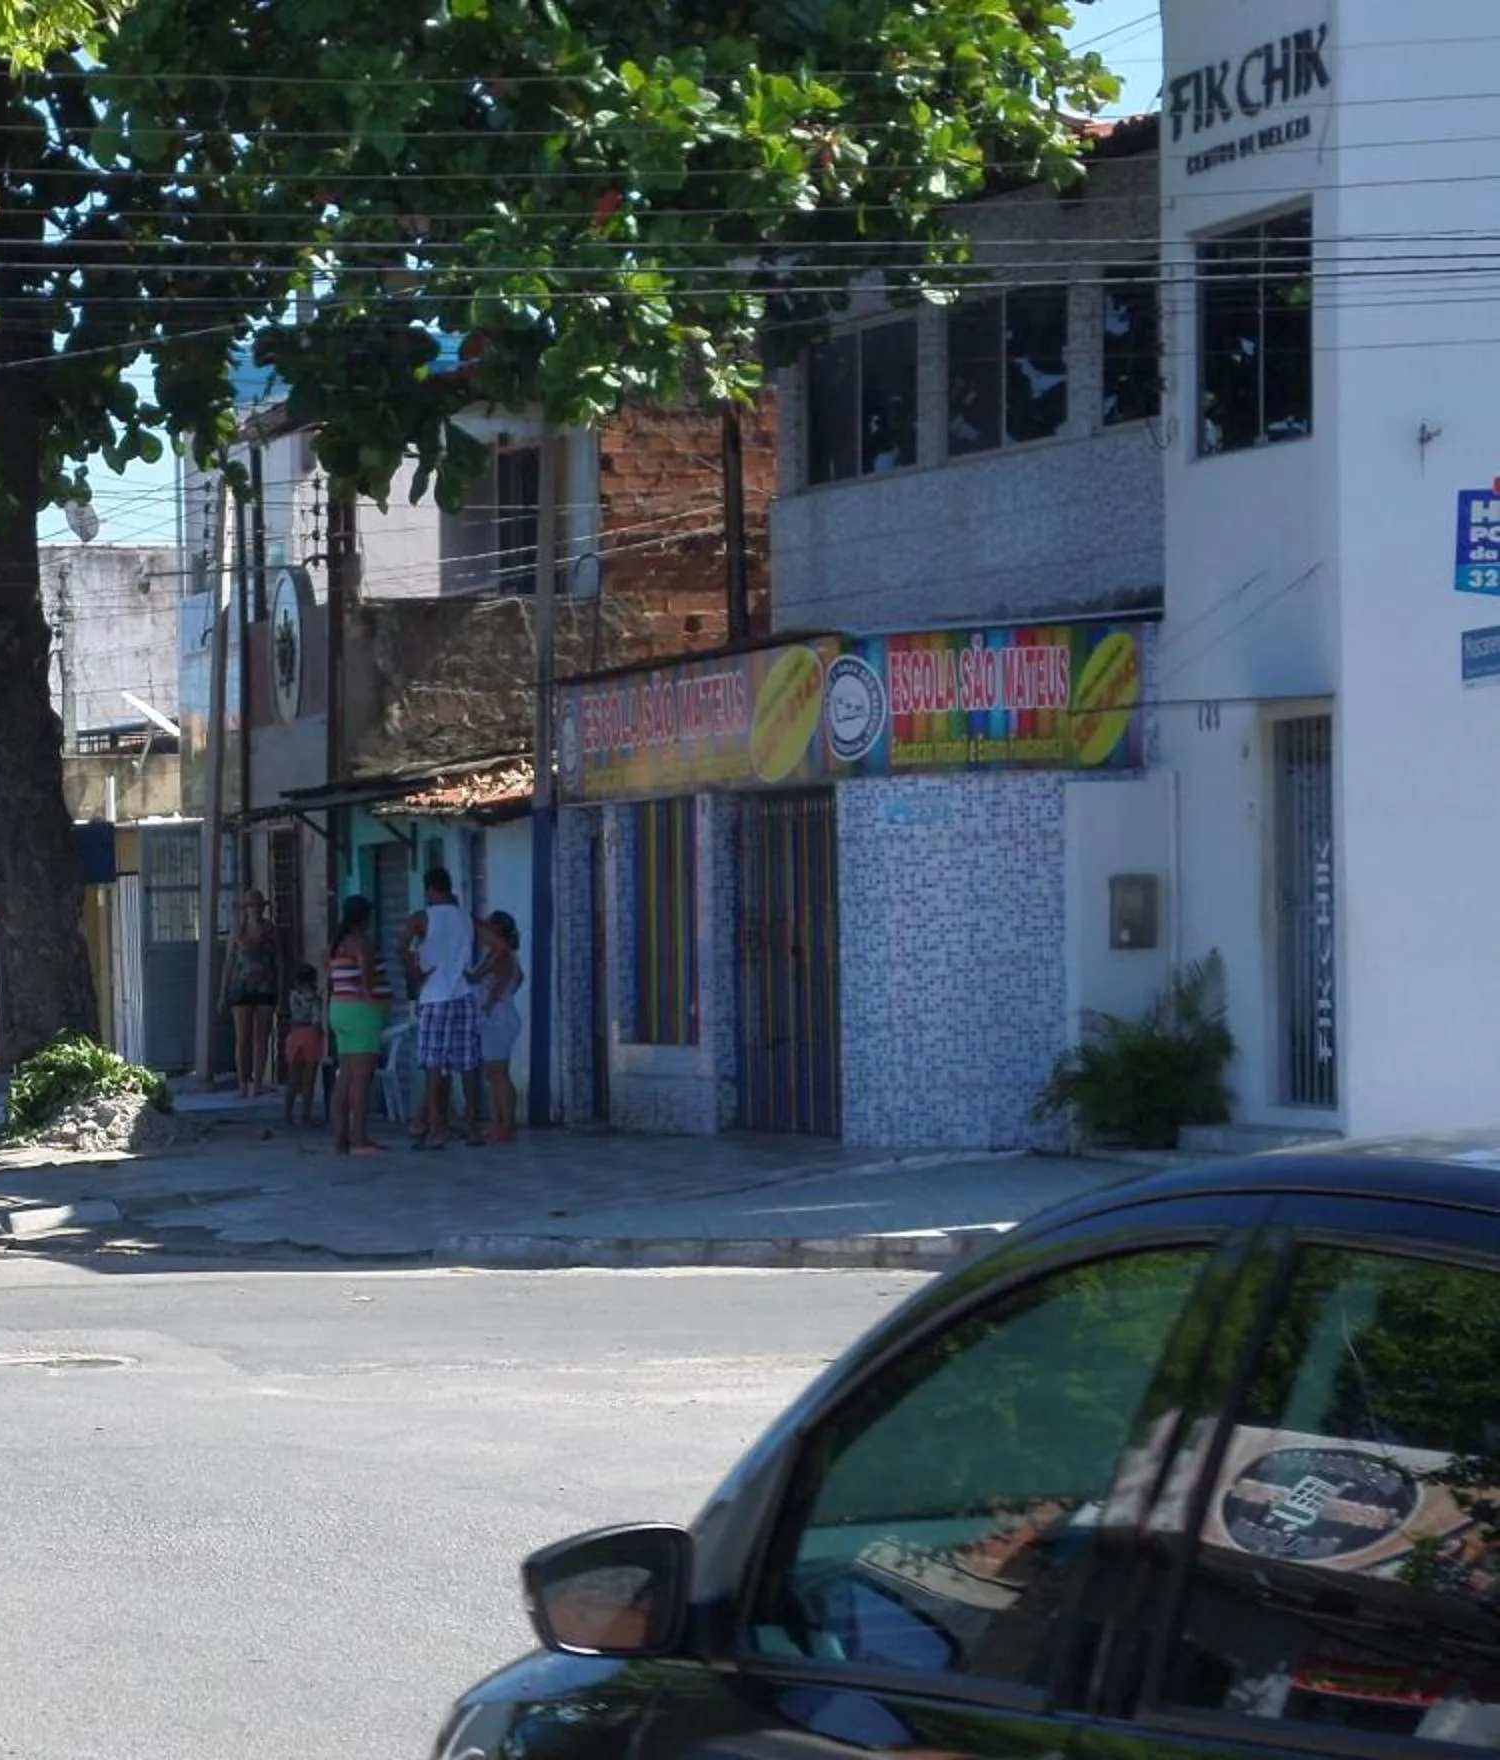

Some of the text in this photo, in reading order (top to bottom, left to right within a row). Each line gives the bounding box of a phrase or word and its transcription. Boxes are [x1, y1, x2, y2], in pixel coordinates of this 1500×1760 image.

[1169, 22, 1331, 142] FIK CHIK
[1186, 115, 1311, 176] CENTRO DE BELEZA
[1469, 545, 1498, 561] da
[677, 668, 747, 741] MATEUS
[888, 648, 958, 715] ESCOLA
[959, 633, 1000, 709] SÃO
[1001, 645, 1071, 710] MATEUS
